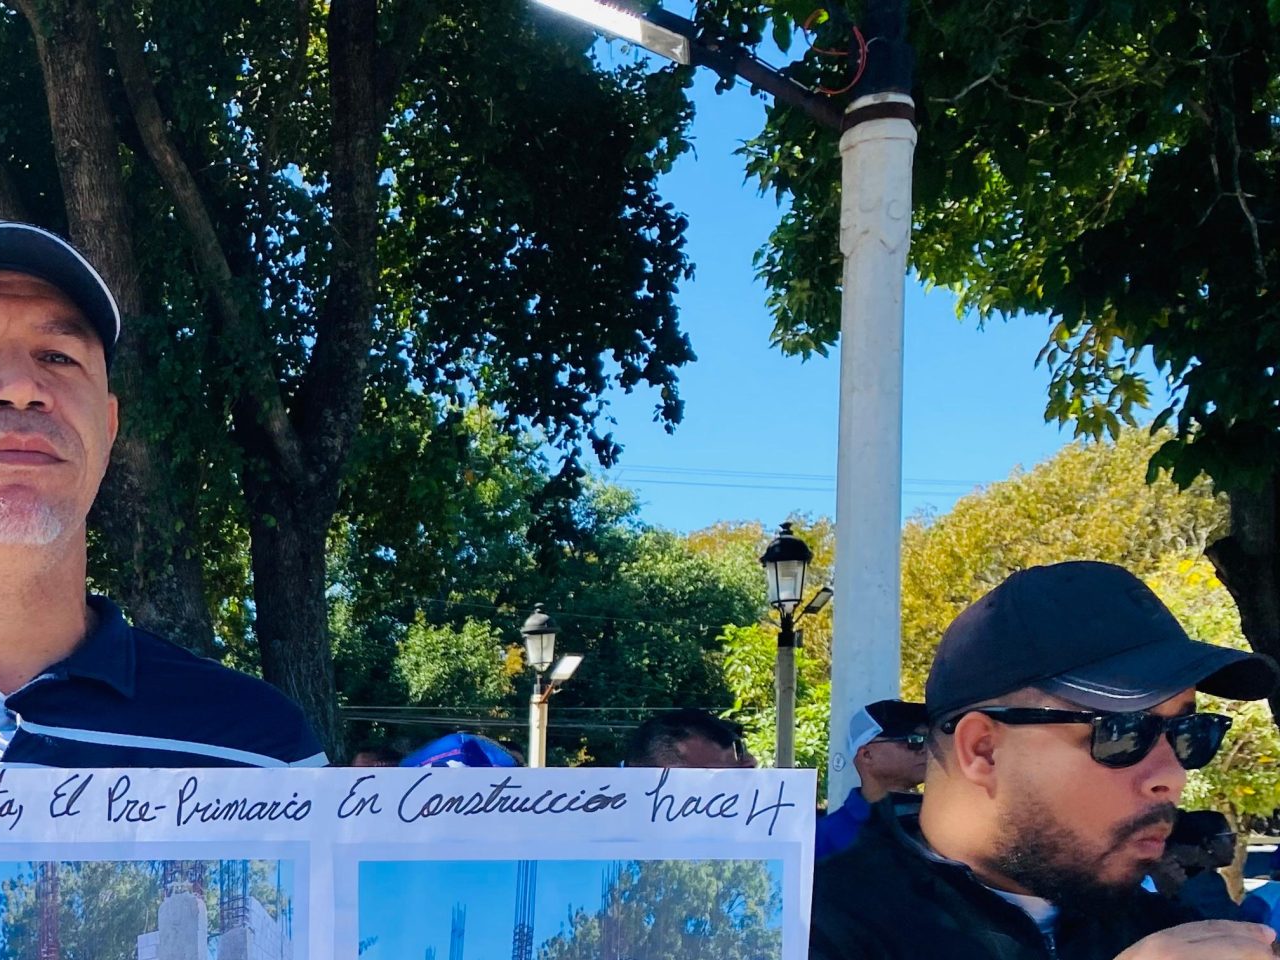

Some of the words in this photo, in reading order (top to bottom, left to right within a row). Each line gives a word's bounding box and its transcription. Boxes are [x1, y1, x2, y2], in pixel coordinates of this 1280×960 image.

[50, 773, 94, 818] El
[107, 774, 313, 827] Pre-Primario
[336, 774, 383, 819] En
[397, 772, 628, 824] Construcción
[644, 769, 740, 823] hace
[745, 781, 796, 837] 4
